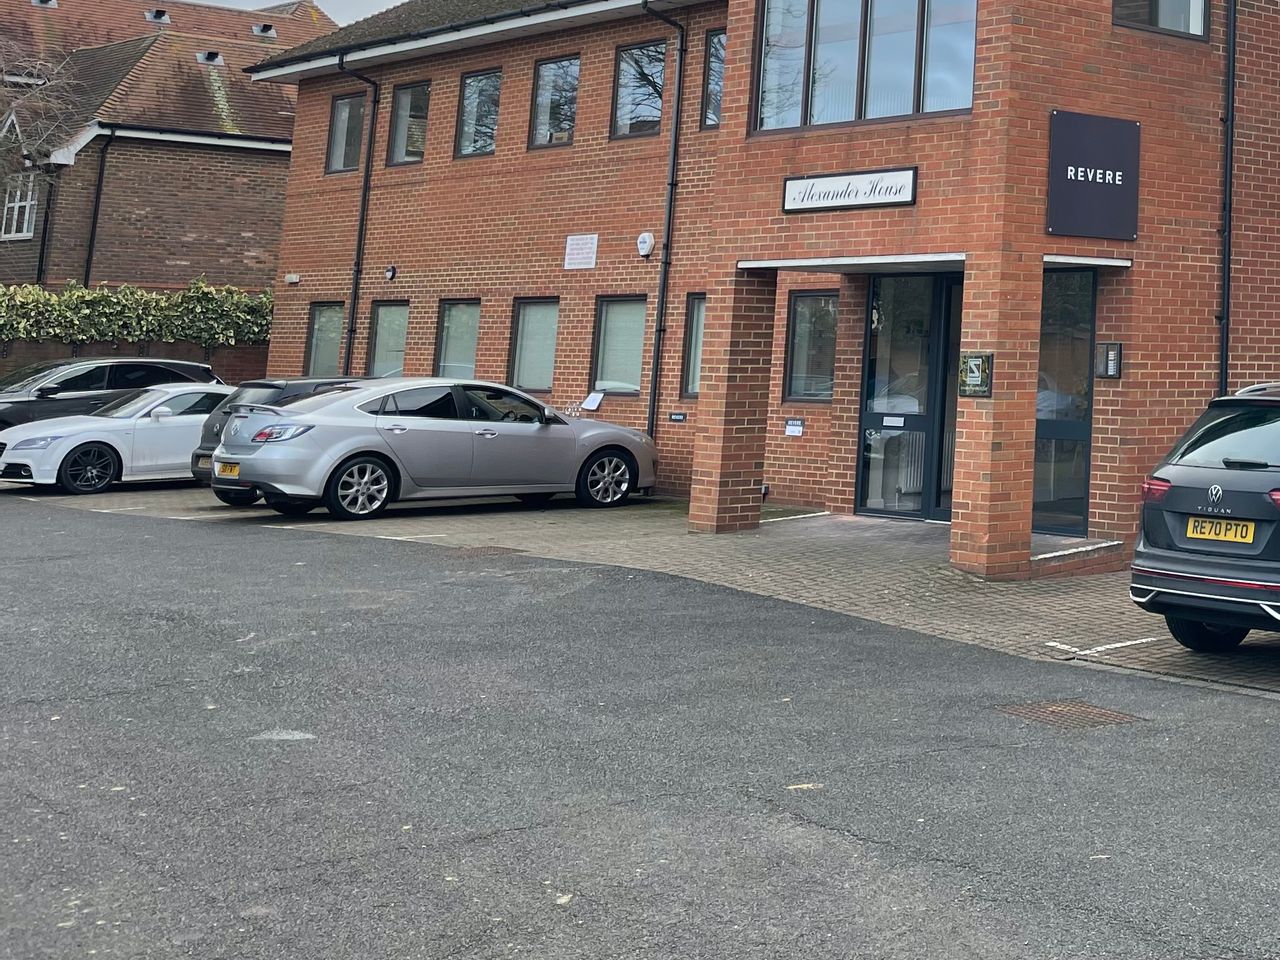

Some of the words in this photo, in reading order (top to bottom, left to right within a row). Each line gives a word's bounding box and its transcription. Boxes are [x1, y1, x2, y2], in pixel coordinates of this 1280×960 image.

[1067, 166, 1123, 185] REVERE
[793, 181, 859, 203] Alexander
[864, 177, 906, 197] House
[1192, 519, 1222, 536] RE70
[1224, 522, 1249, 539] PTO
